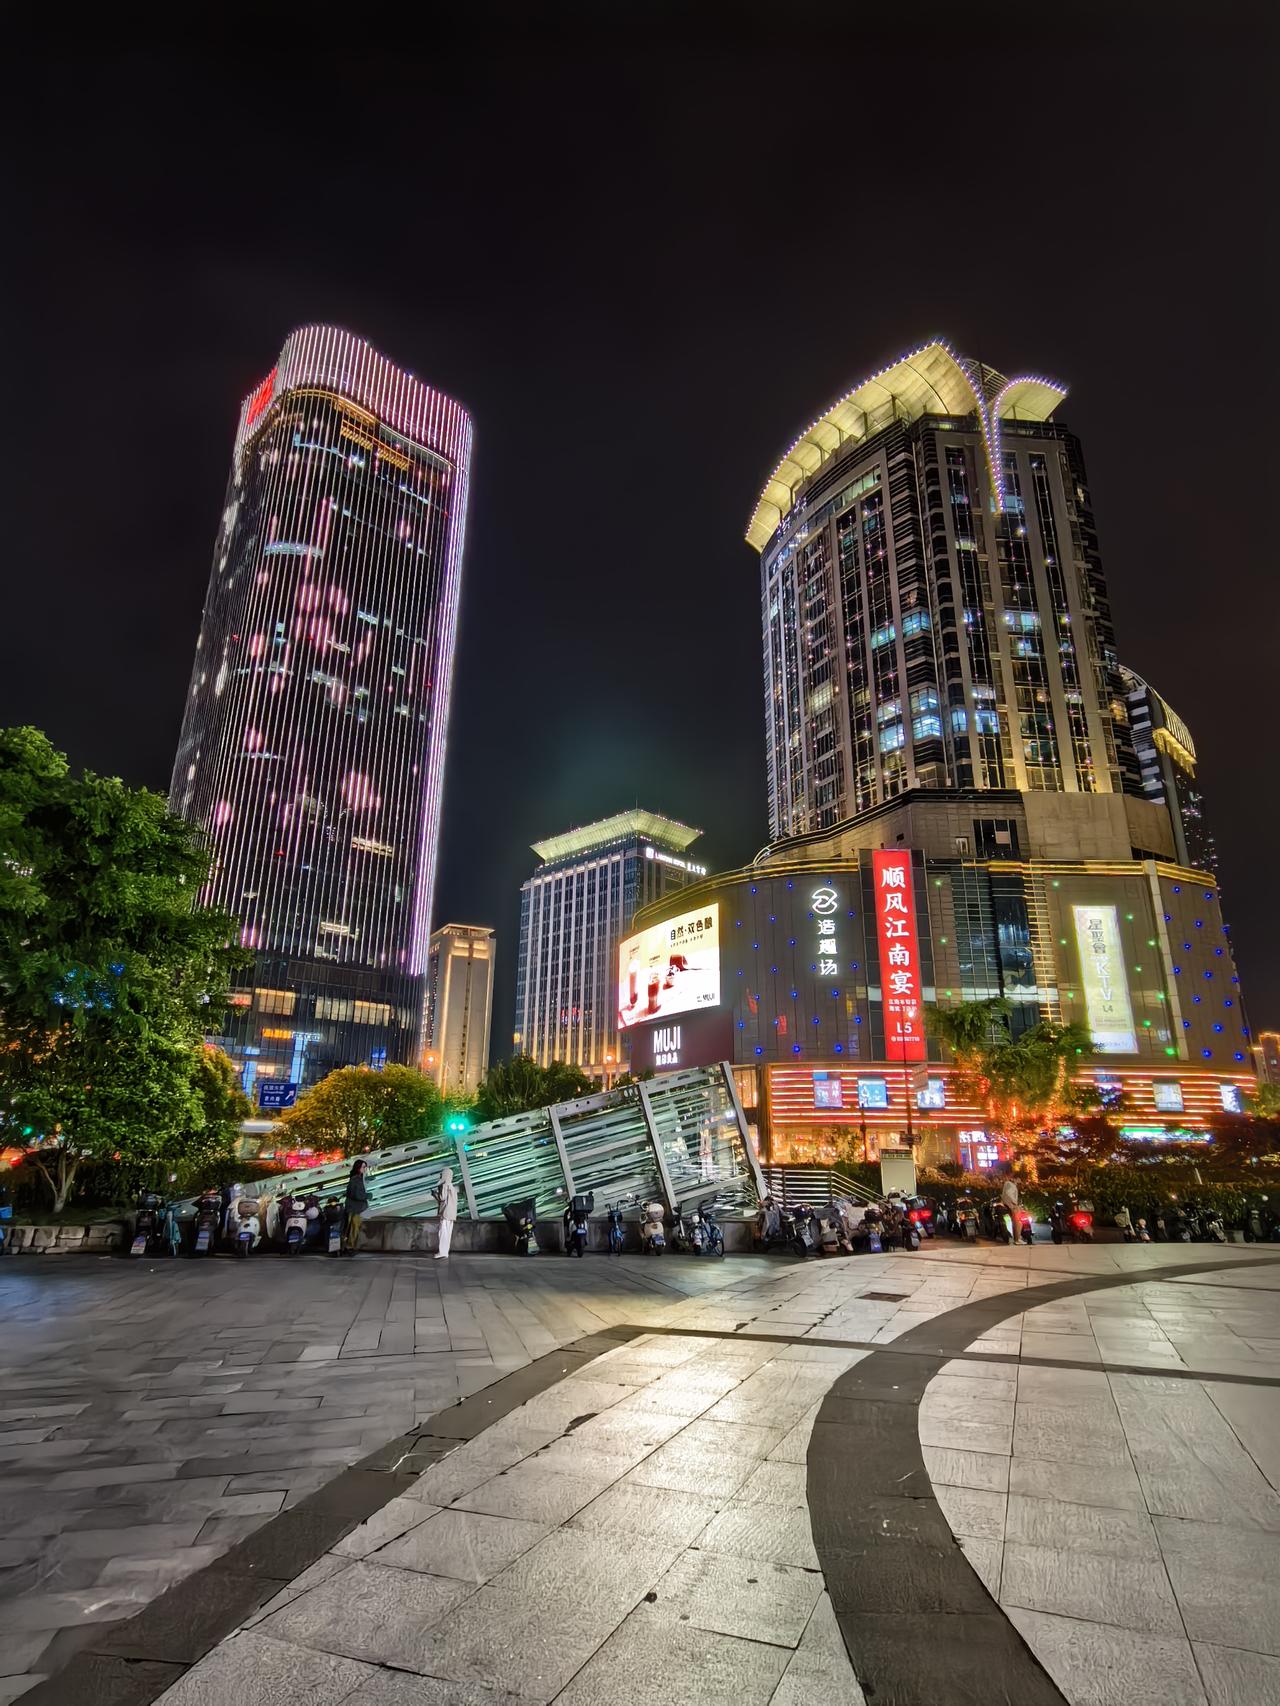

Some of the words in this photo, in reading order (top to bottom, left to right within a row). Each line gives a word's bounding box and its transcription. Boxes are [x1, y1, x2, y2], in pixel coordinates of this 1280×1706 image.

[881, 866, 914, 995] 顺风江南宴
[1096, 961, 1113, 1000] KTV
[653, 1025, 681, 1054] MUJI
[896, 1021, 912, 1034] L5
